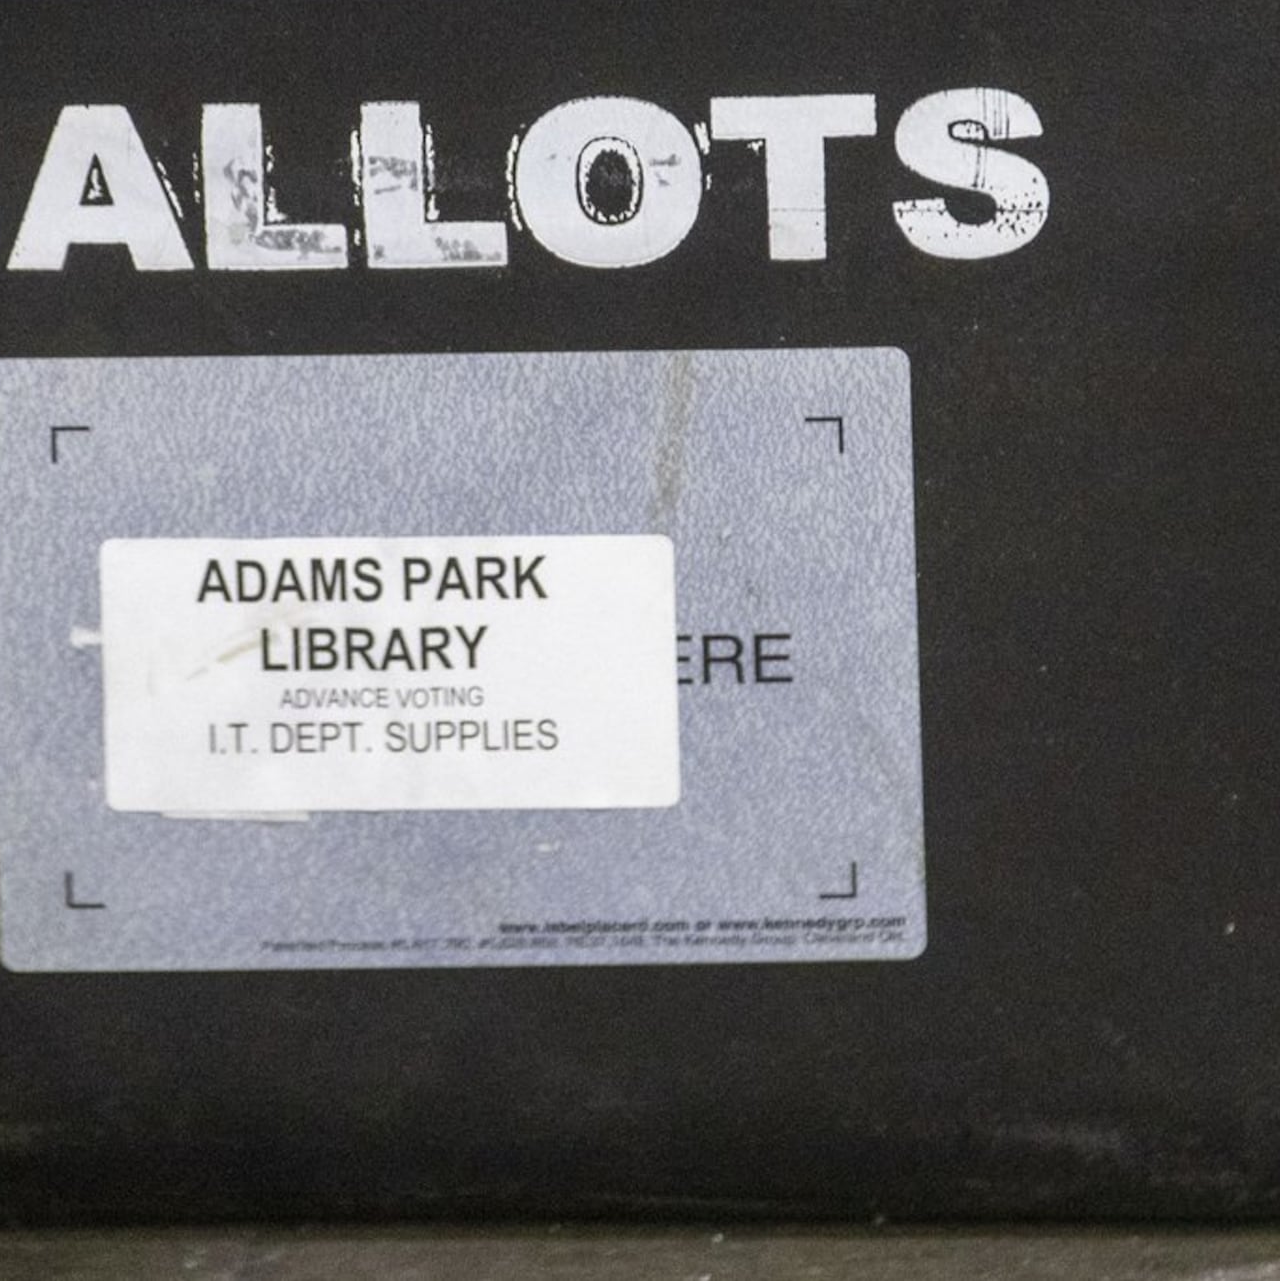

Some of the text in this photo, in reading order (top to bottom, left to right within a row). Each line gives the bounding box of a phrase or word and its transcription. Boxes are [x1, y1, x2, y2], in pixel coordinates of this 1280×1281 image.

[196, 554, 549, 604] ADAMS PARK
[260, 624, 488, 672] LIBRARY
[279, 685, 484, 710] ADVANCE VOTING
[208, 717, 560, 755] I.T. DEPT. SUPPLIES
